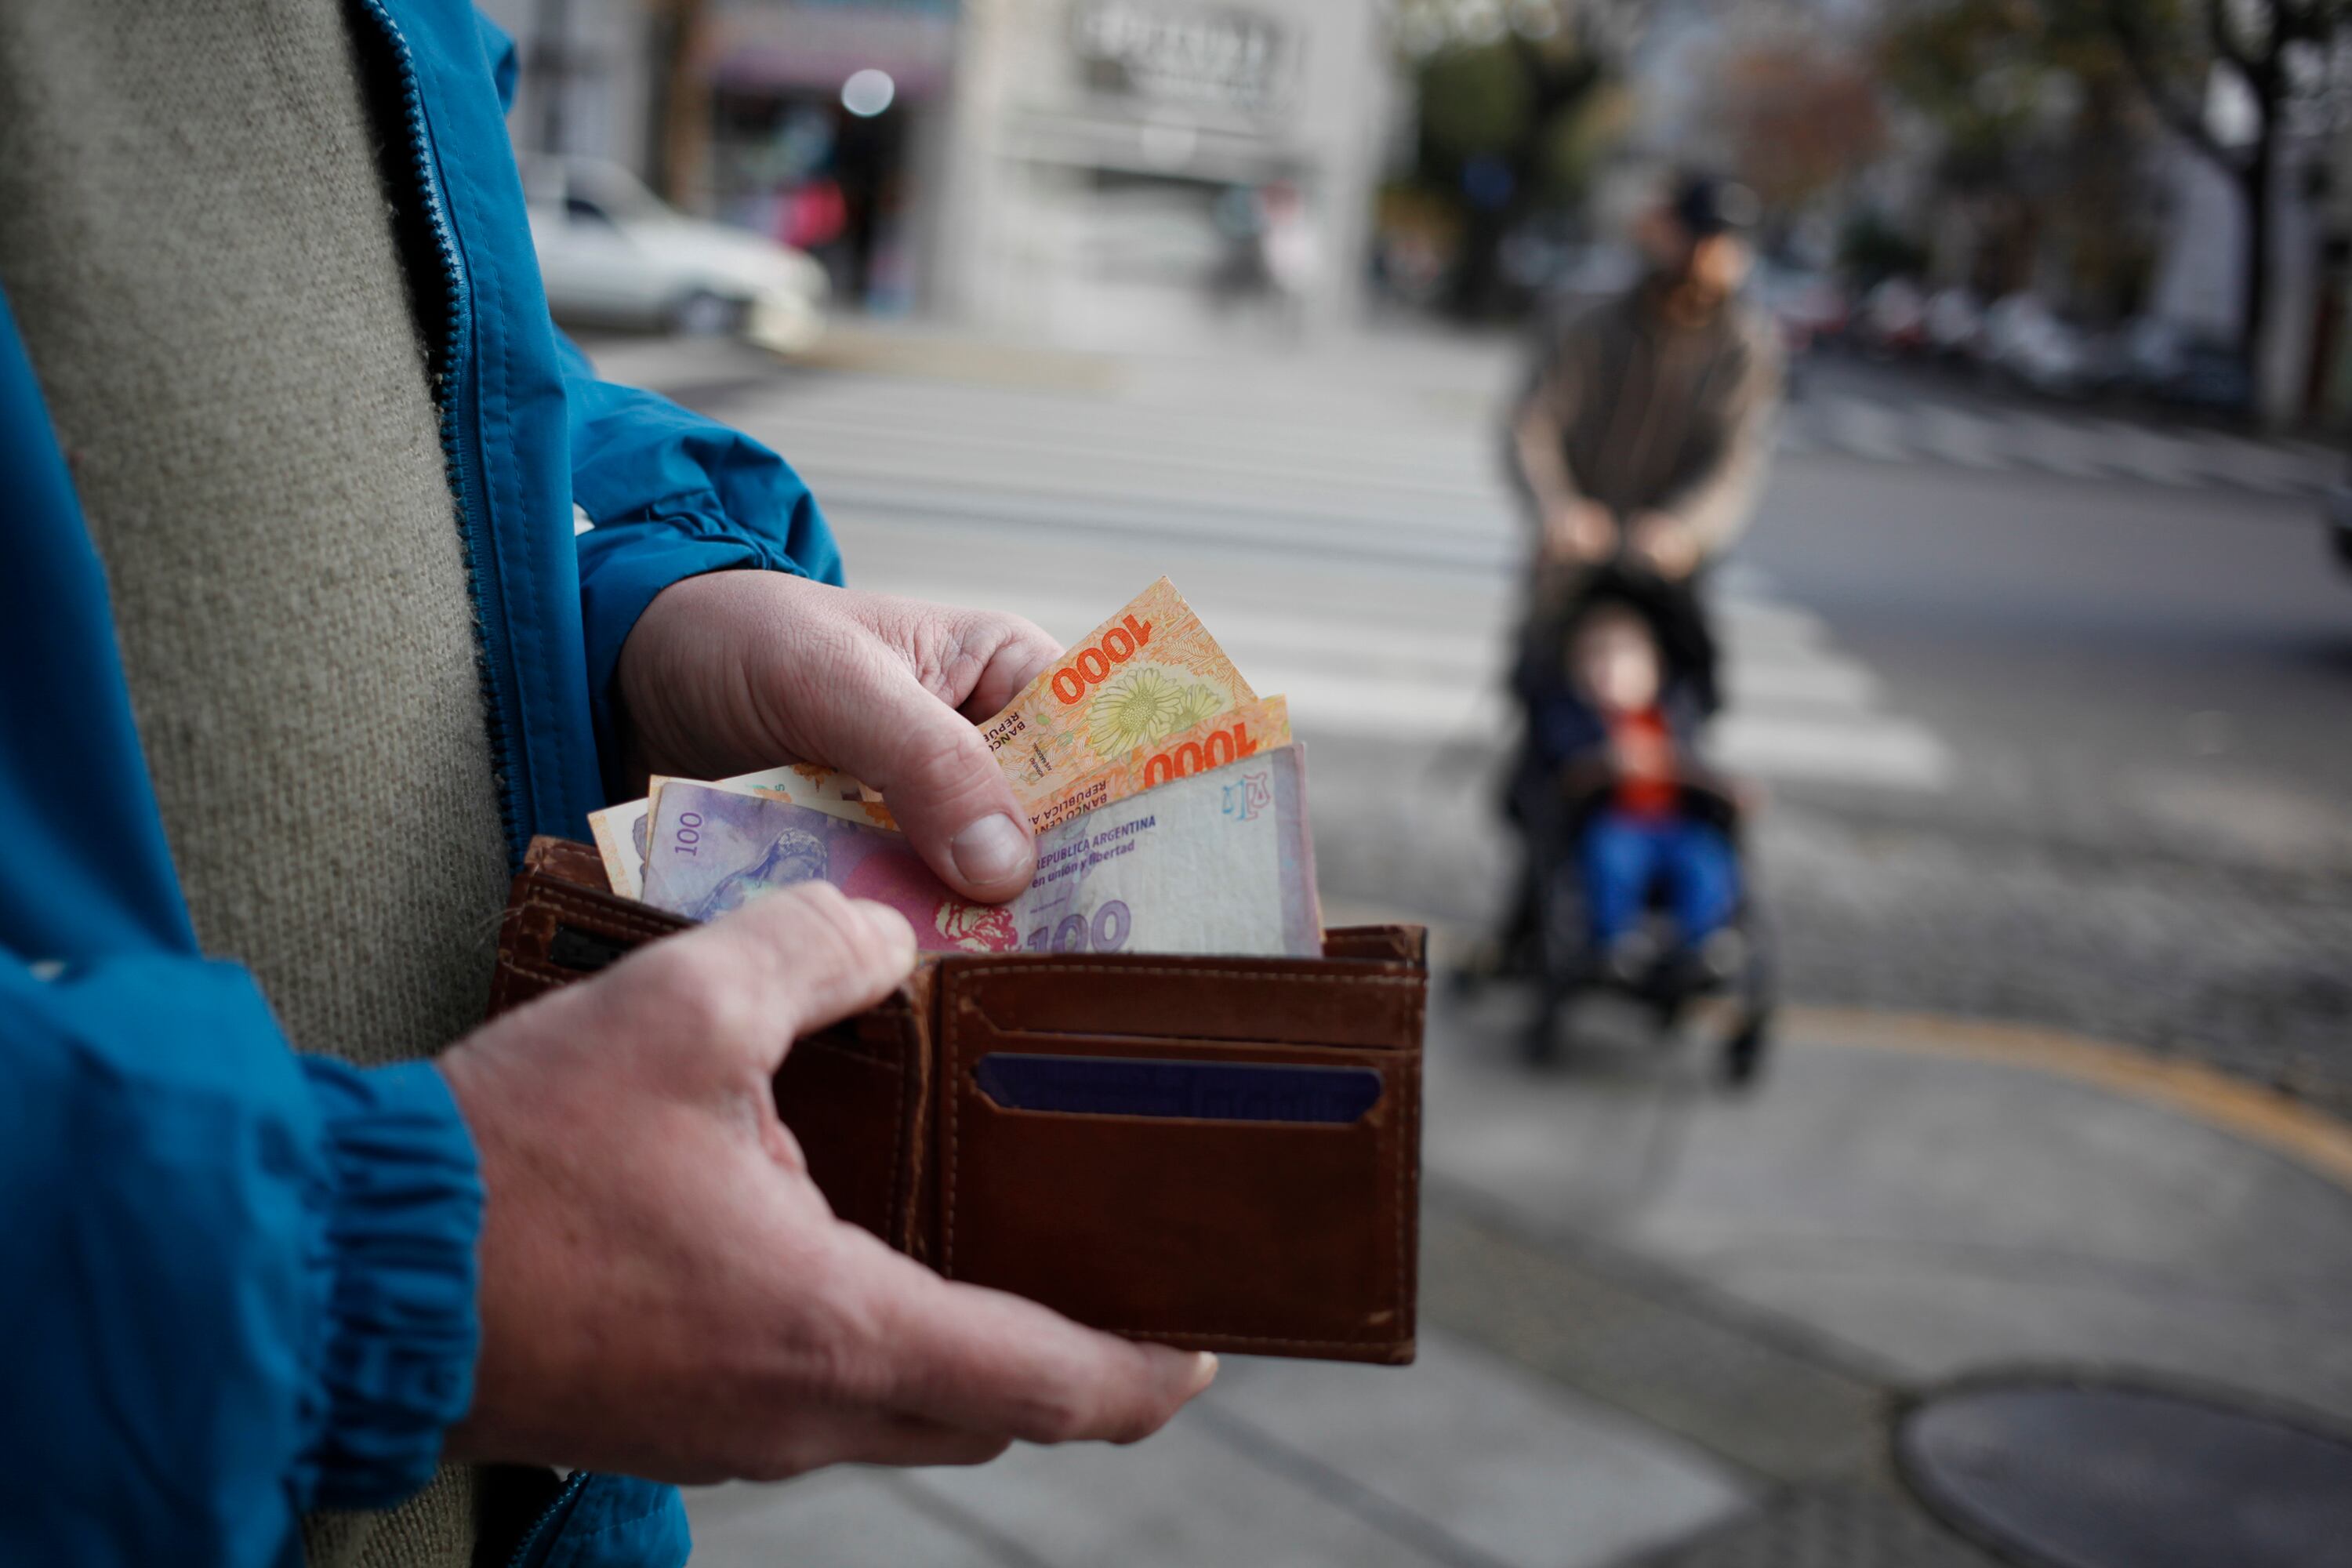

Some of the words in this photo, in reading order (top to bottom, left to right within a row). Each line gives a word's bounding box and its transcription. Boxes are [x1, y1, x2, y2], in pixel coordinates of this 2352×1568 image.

[1052, 614, 1152, 705] 1000
[1145, 722, 1257, 789] 1000
[1066, 793, 1107, 819] BANCO
[675, 812, 702, 856] 100
[1092, 815, 1156, 848] ARGENTINA
[1032, 876, 1045, 888] en
[1089, 839, 1135, 866] libertad
[1027, 899, 1131, 953] 100
